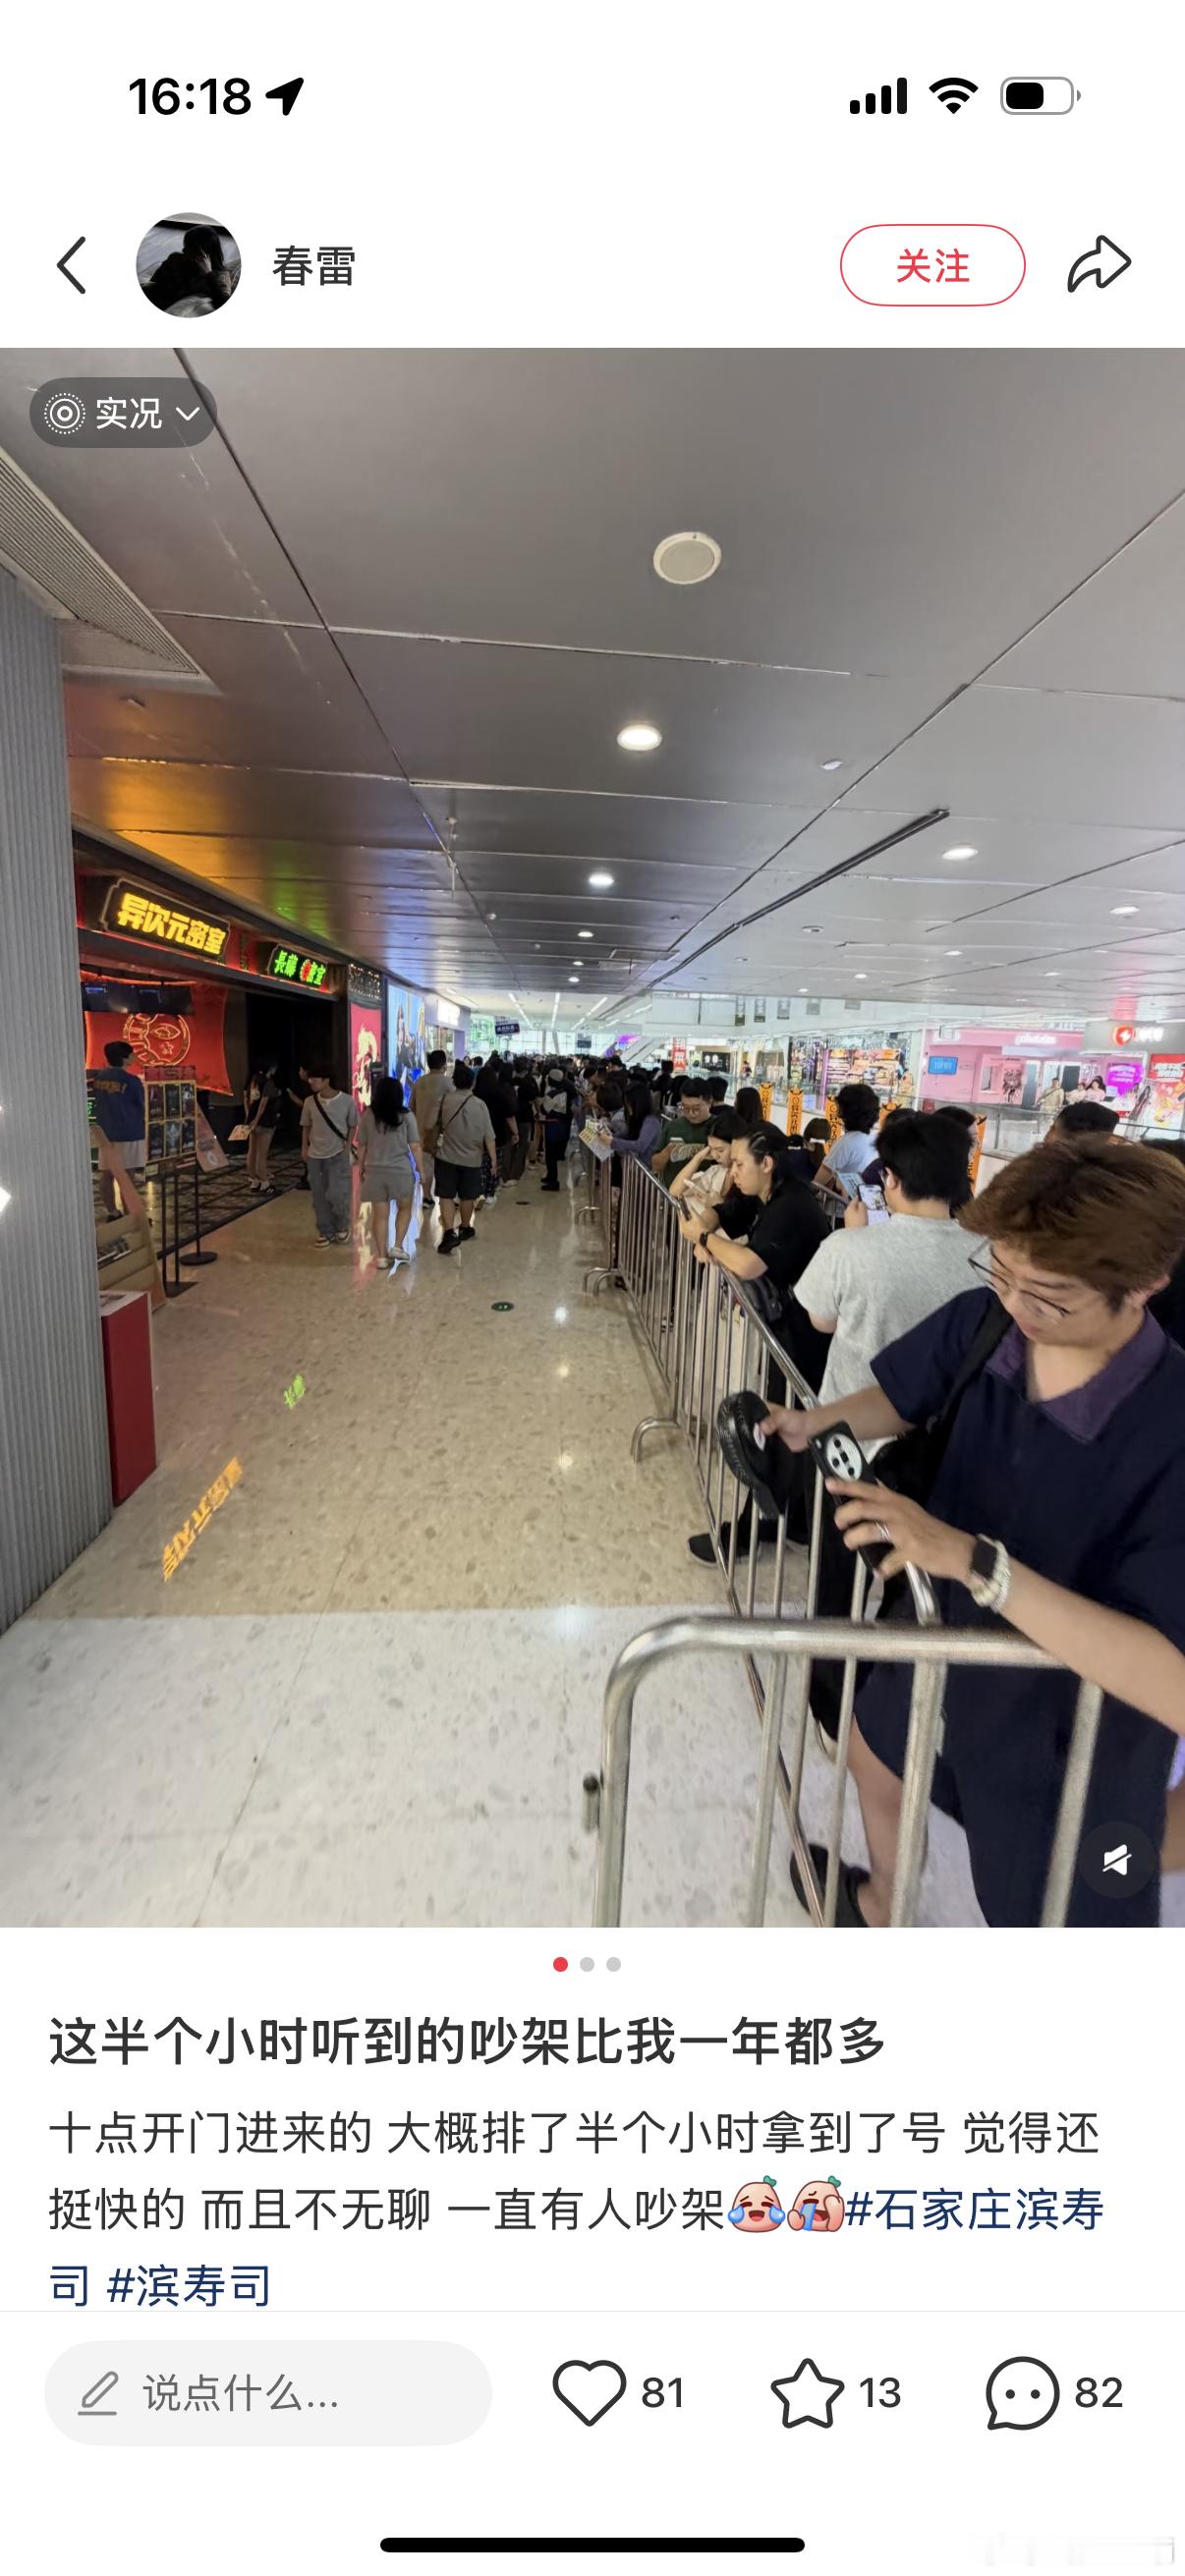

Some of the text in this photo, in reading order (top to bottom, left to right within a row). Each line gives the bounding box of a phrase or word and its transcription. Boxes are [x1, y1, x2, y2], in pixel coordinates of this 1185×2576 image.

[117, 892, 226, 955] 异次元密室
